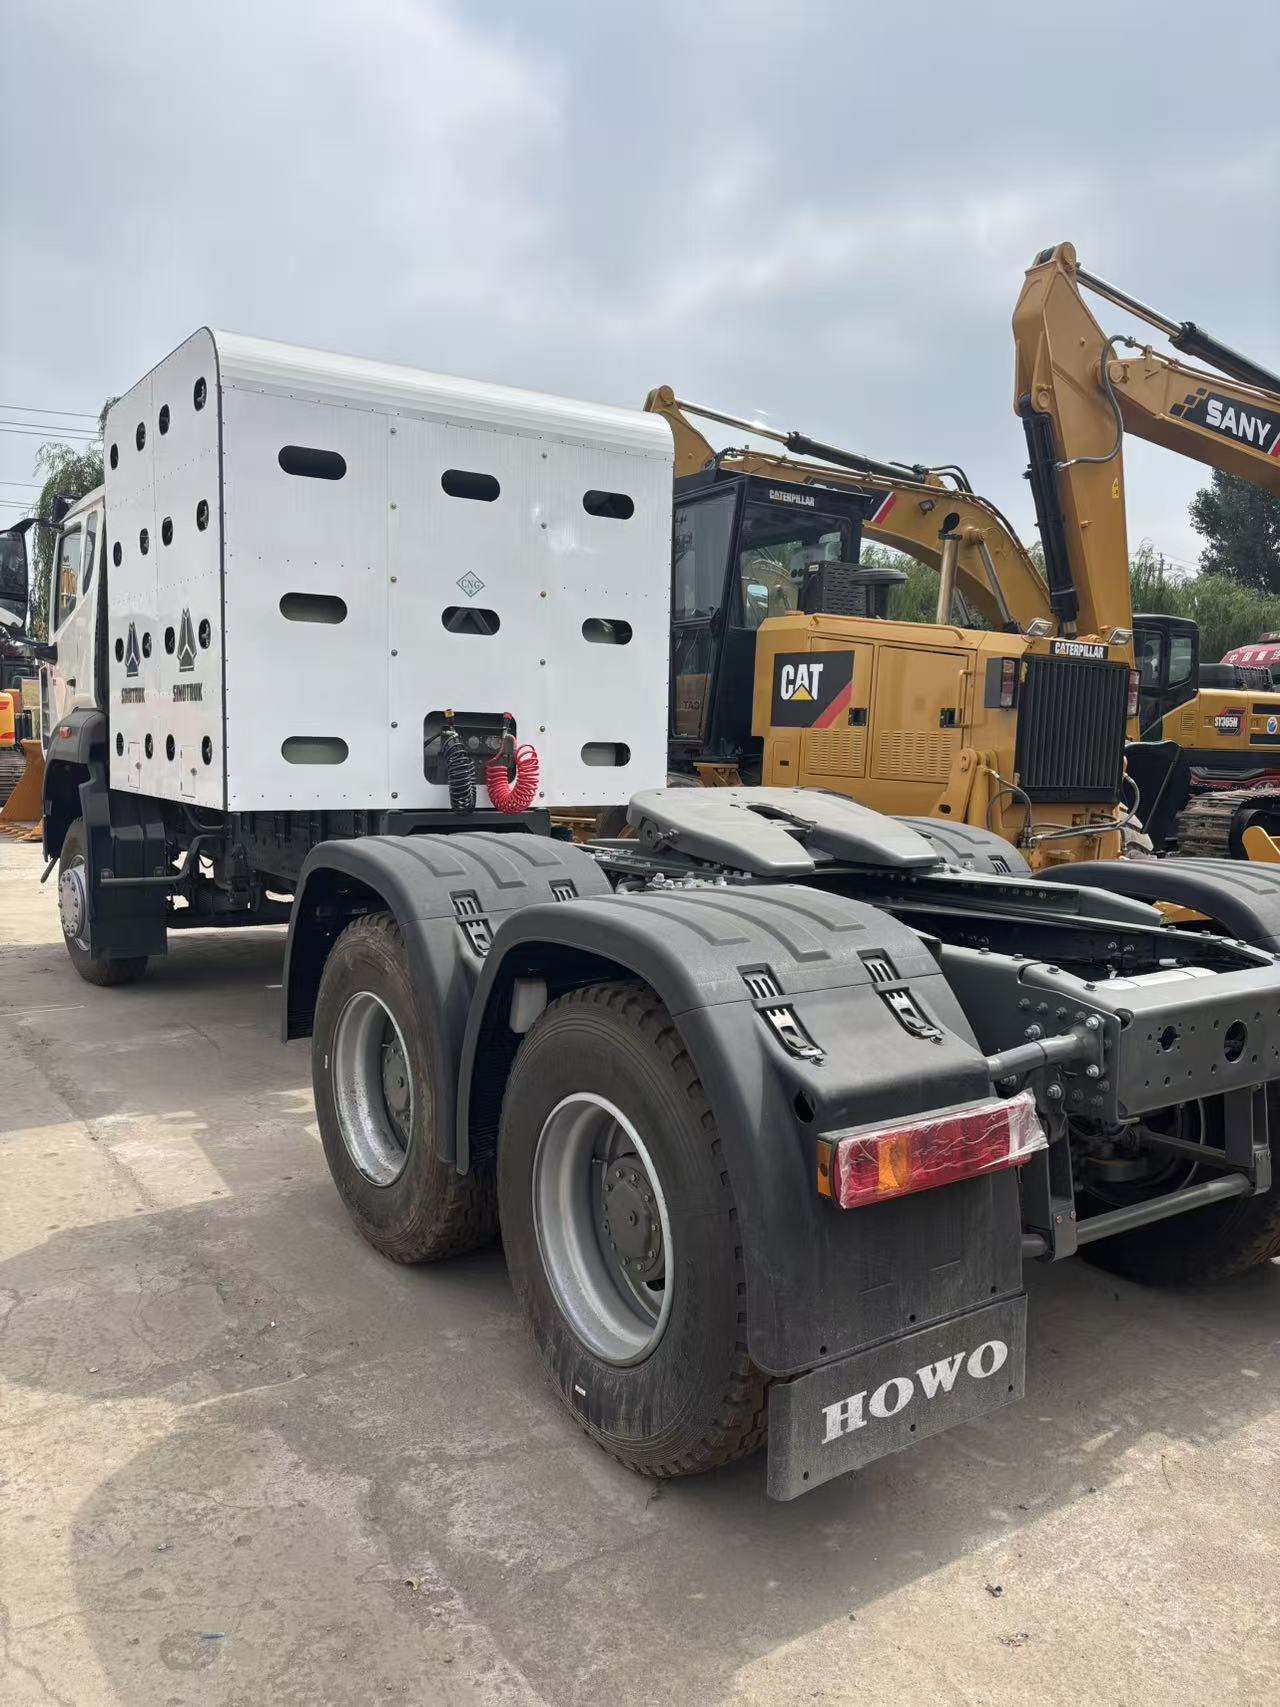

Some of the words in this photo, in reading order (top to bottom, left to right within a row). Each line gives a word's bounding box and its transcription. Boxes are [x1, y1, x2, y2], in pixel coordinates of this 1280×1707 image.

[1206, 398, 1271, 445] SANY
[769, 489, 815, 507] CATERPILLAR
[461, 579, 480, 589] CNG
[1055, 641, 1104, 659] CATERPILLAR
[781, 663, 823, 700] CAT
[173, 683, 203, 702] SINOTRUK
[821, 1340, 1008, 1444] HOWO
